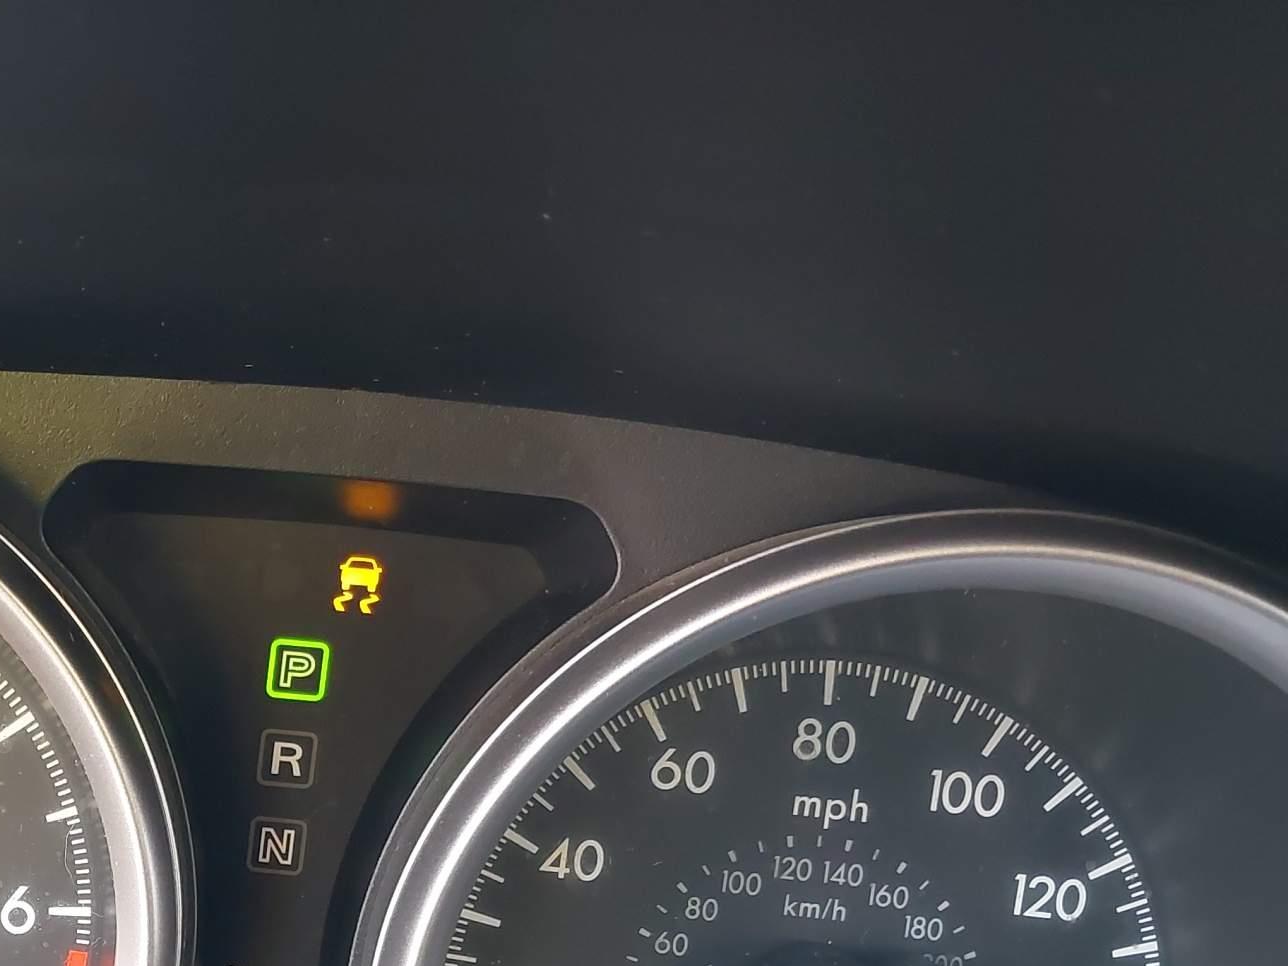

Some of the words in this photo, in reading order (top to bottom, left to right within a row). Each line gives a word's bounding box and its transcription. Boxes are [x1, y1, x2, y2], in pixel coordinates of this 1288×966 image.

[279, 650, 317, 687] P
[792, 717, 856, 764] 80
[271, 742, 303, 777] R
[650, 748, 716, 794] 60
[792, 788, 869, 829] mph
[930, 769, 1005, 818] 100
[260, 827, 294, 864] N
[538, 838, 604, 882] 40
[721, 869, 762, 896] 100
[773, 855, 813, 882] 120
[823, 860, 864, 887] 140
[0, 885, 36, 935] 6
[684, 896, 719, 922] 80
[783, 896, 847, 922] km/h
[869, 882, 909, 910] 160
[1013, 873, 1087, 922] 120
[654, 931, 689, 957] 60
[904, 915, 944, 941] 180
